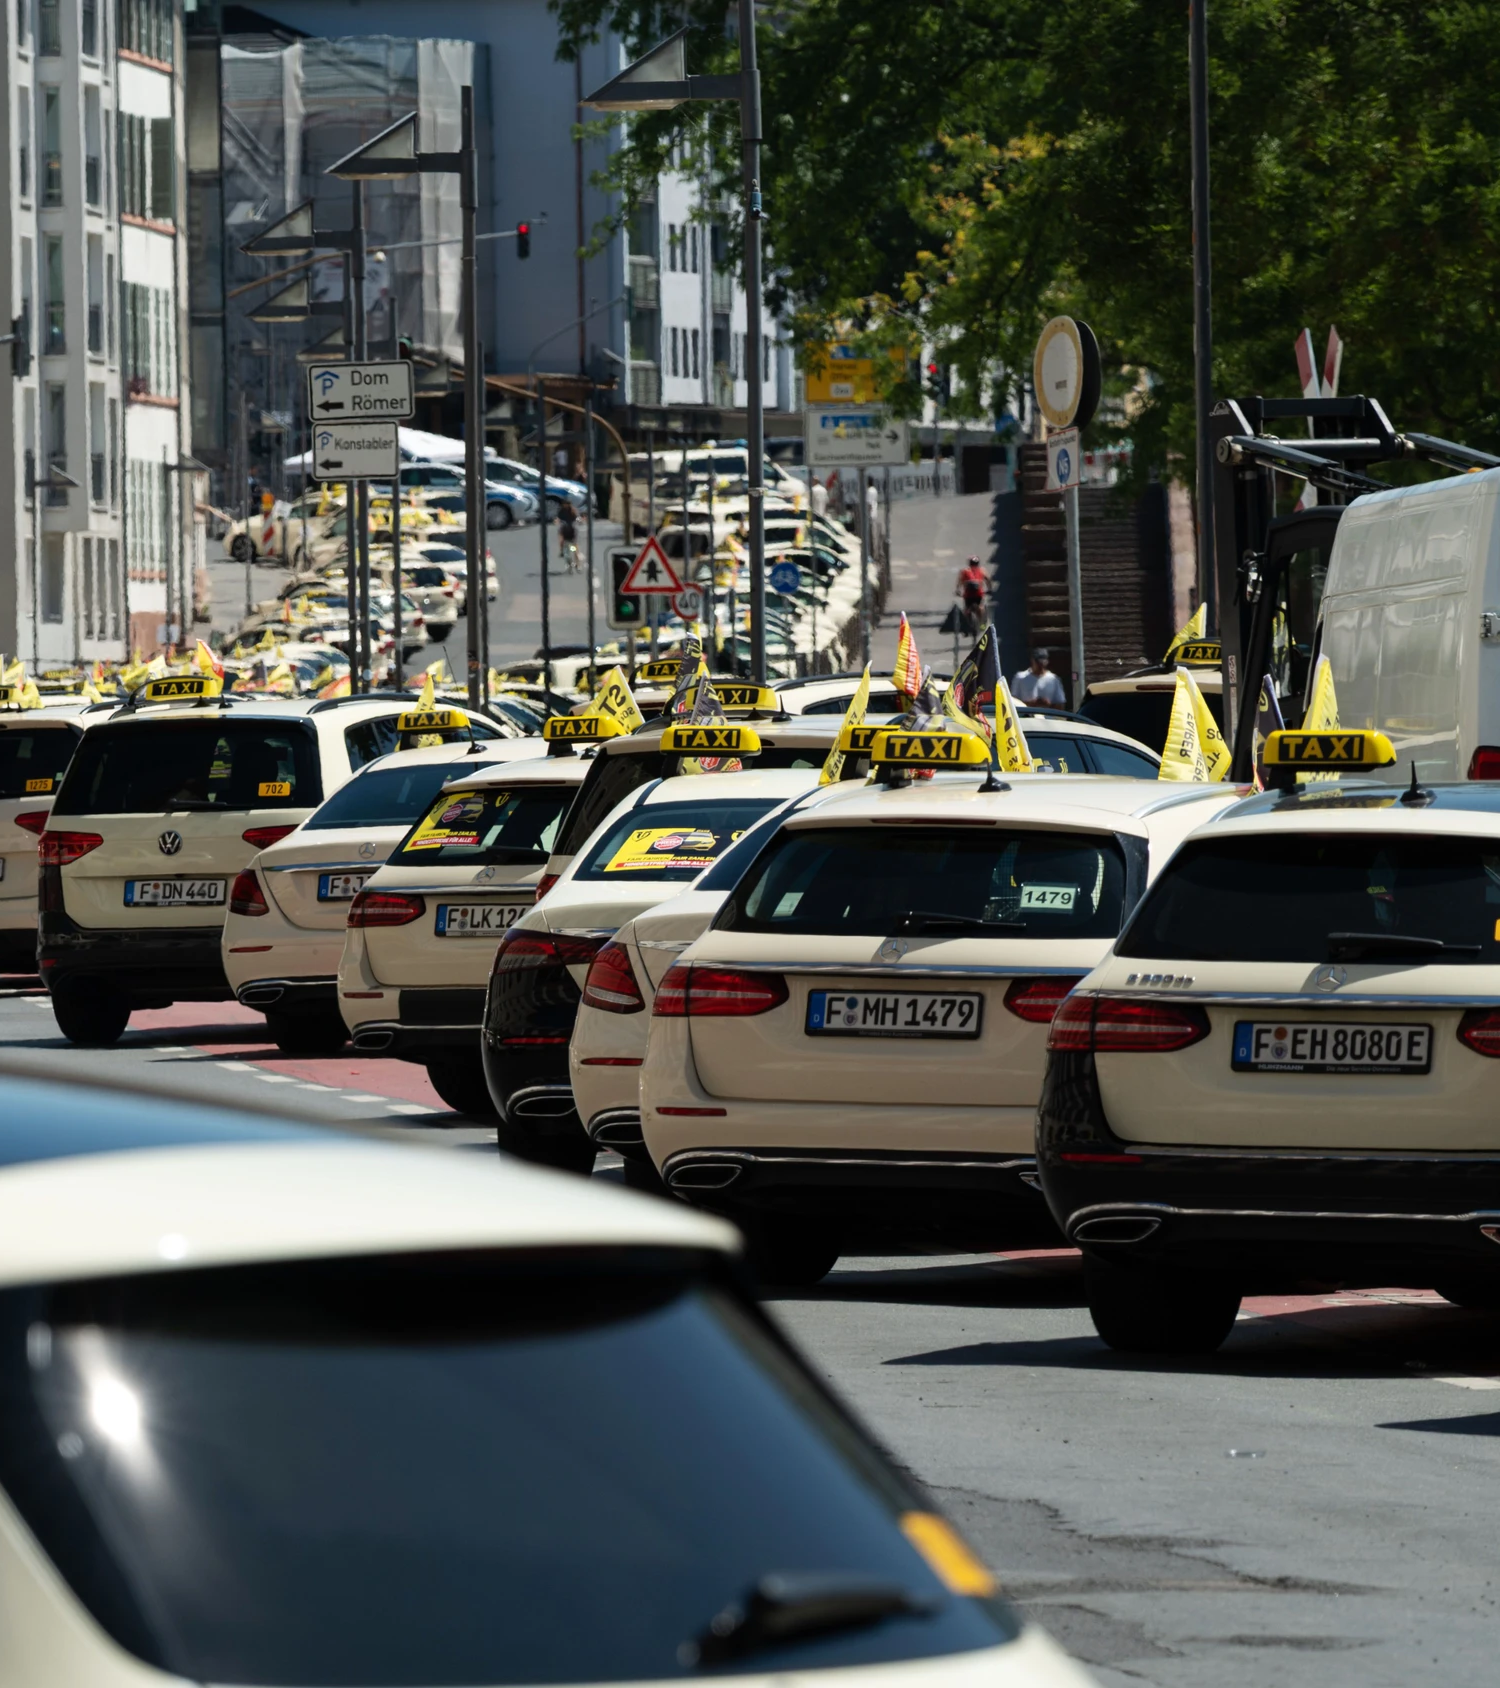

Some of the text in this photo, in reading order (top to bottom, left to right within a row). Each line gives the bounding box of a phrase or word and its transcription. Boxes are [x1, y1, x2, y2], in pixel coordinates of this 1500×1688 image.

[350, 370, 389, 386] Dom
[351, 394, 407, 411] Römer
[334, 437, 394, 451] Konstabler
[1188, 647, 1219, 658] TAXI
[653, 665, 682, 675] TAX
[158, 681, 198, 695] TAXI
[407, 712, 449, 726] TAXI
[553, 719, 596, 735] TAXI
[677, 730, 738, 747] TAXI
[889, 738, 958, 758] TAXI
[1282, 736, 1361, 759] TAXI
[29, 780, 49, 790] 1275
[264, 784, 284, 794] 702
[161, 882, 183, 899] DN
[186, 882, 218, 899] 440
[1024, 890, 1073, 906] 1479
[470, 907, 493, 928] LK
[861, 997, 900, 1026] MH
[903, 998, 974, 1028] 1479
[1290, 1028, 1328, 1060] EH
